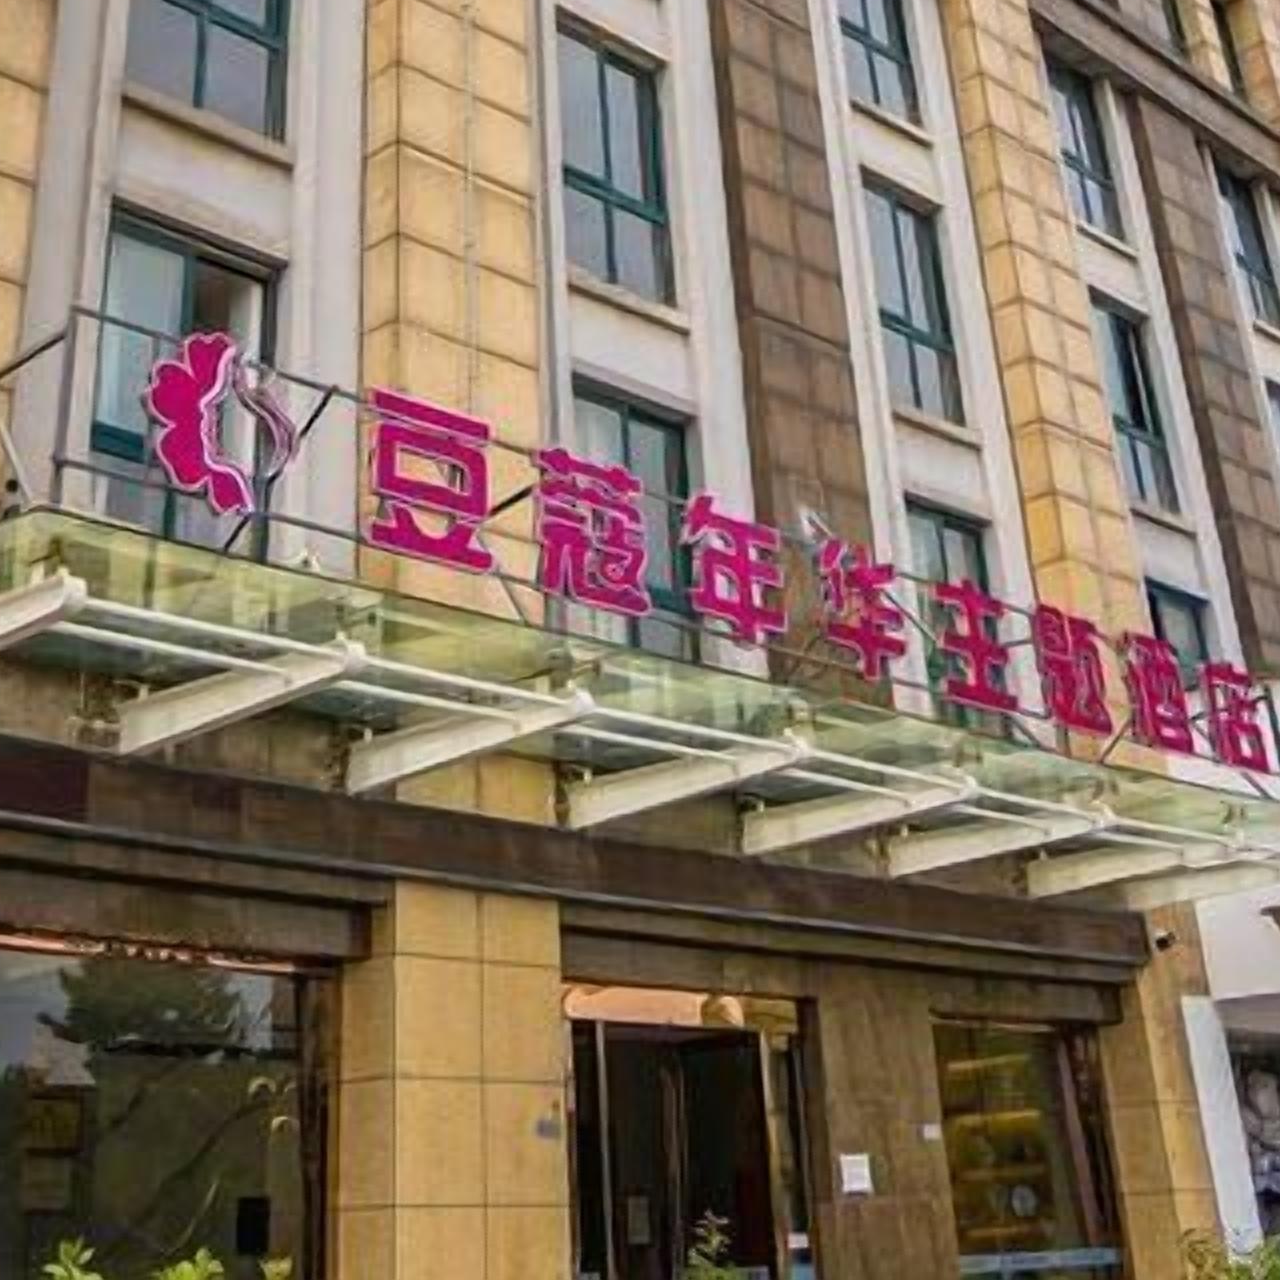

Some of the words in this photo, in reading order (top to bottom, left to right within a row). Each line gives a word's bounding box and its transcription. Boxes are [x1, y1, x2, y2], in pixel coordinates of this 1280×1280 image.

[367, 386, 1269, 774] 豆蔻年华主题酒店
